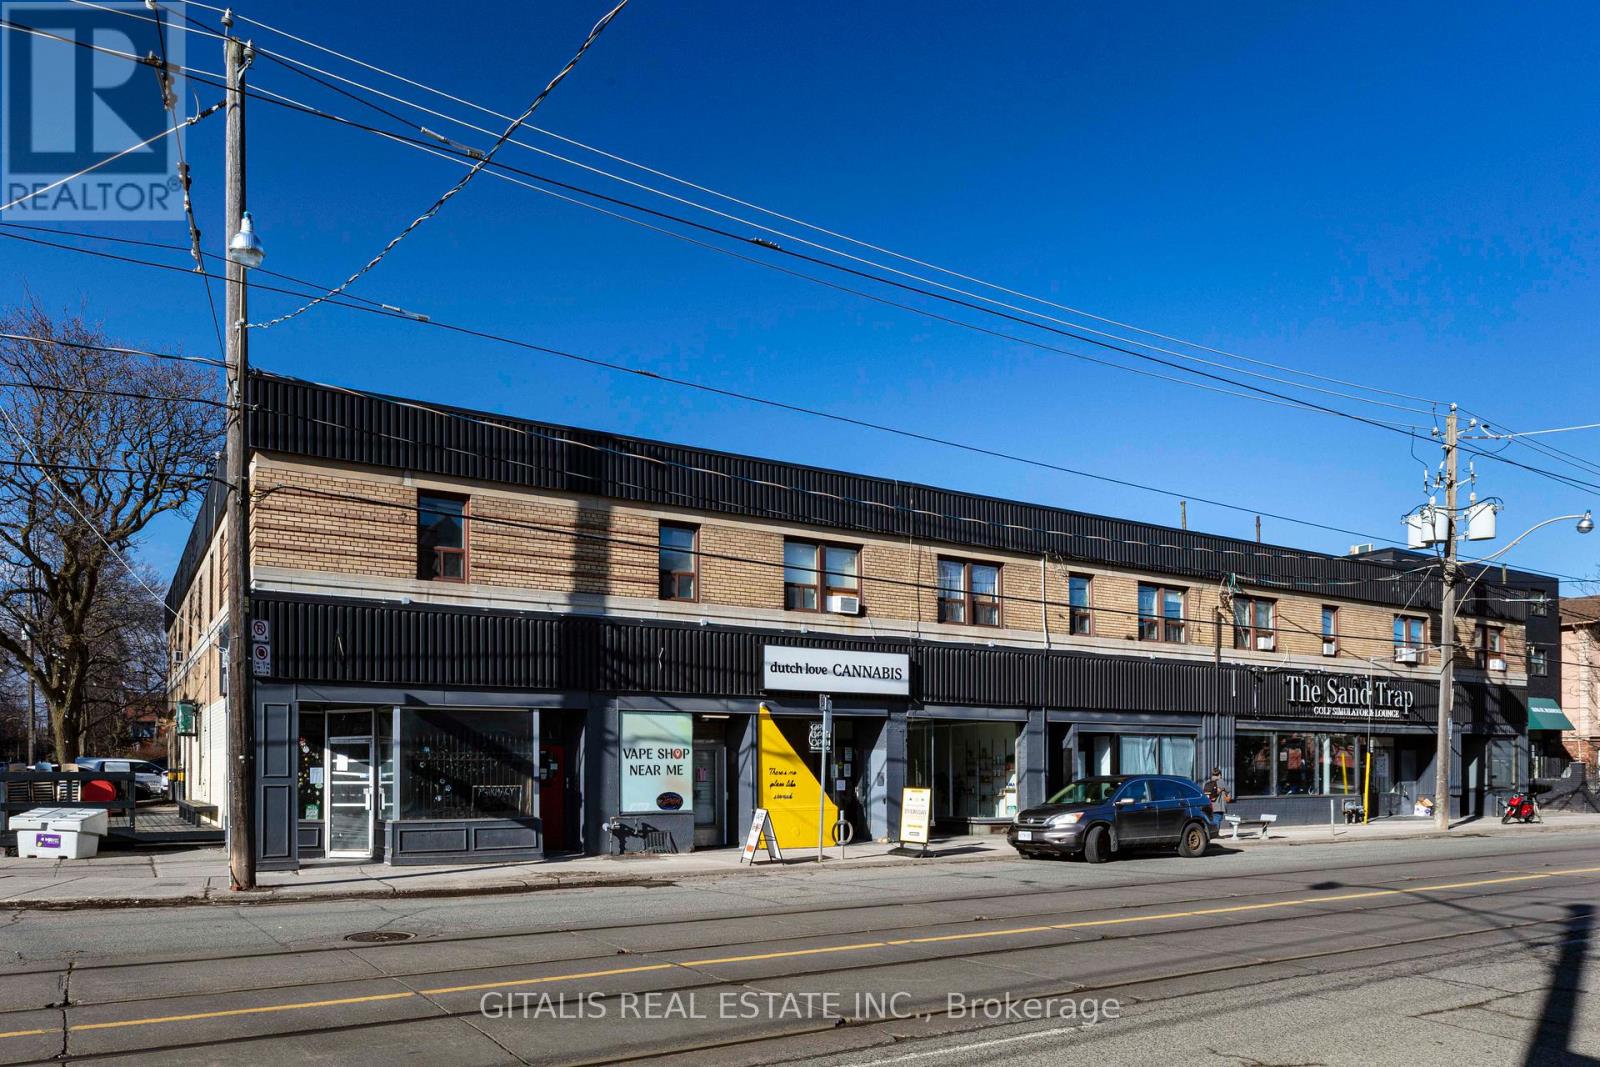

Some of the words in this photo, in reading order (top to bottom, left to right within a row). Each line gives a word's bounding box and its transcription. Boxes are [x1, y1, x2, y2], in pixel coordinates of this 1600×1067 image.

[770, 661, 803, 674] dutch
[805, 663, 828, 675] love
[832, 663, 902, 680] CANNABIS
[1286, 675, 1321, 703] The
[1327, 678, 1371, 704] Sand
[1376, 681, 1413, 714] Trap
[1314, 706, 1331, 715] GOLF
[1332, 707, 1369, 717] SIMULATOR
[1375, 709, 1400, 718] LOUNGE
[623, 748, 653, 760] VAPE
[657, 748, 690, 760] SHOP
[630, 765, 661, 776] NEAR
[667, 765, 684, 776] ME
